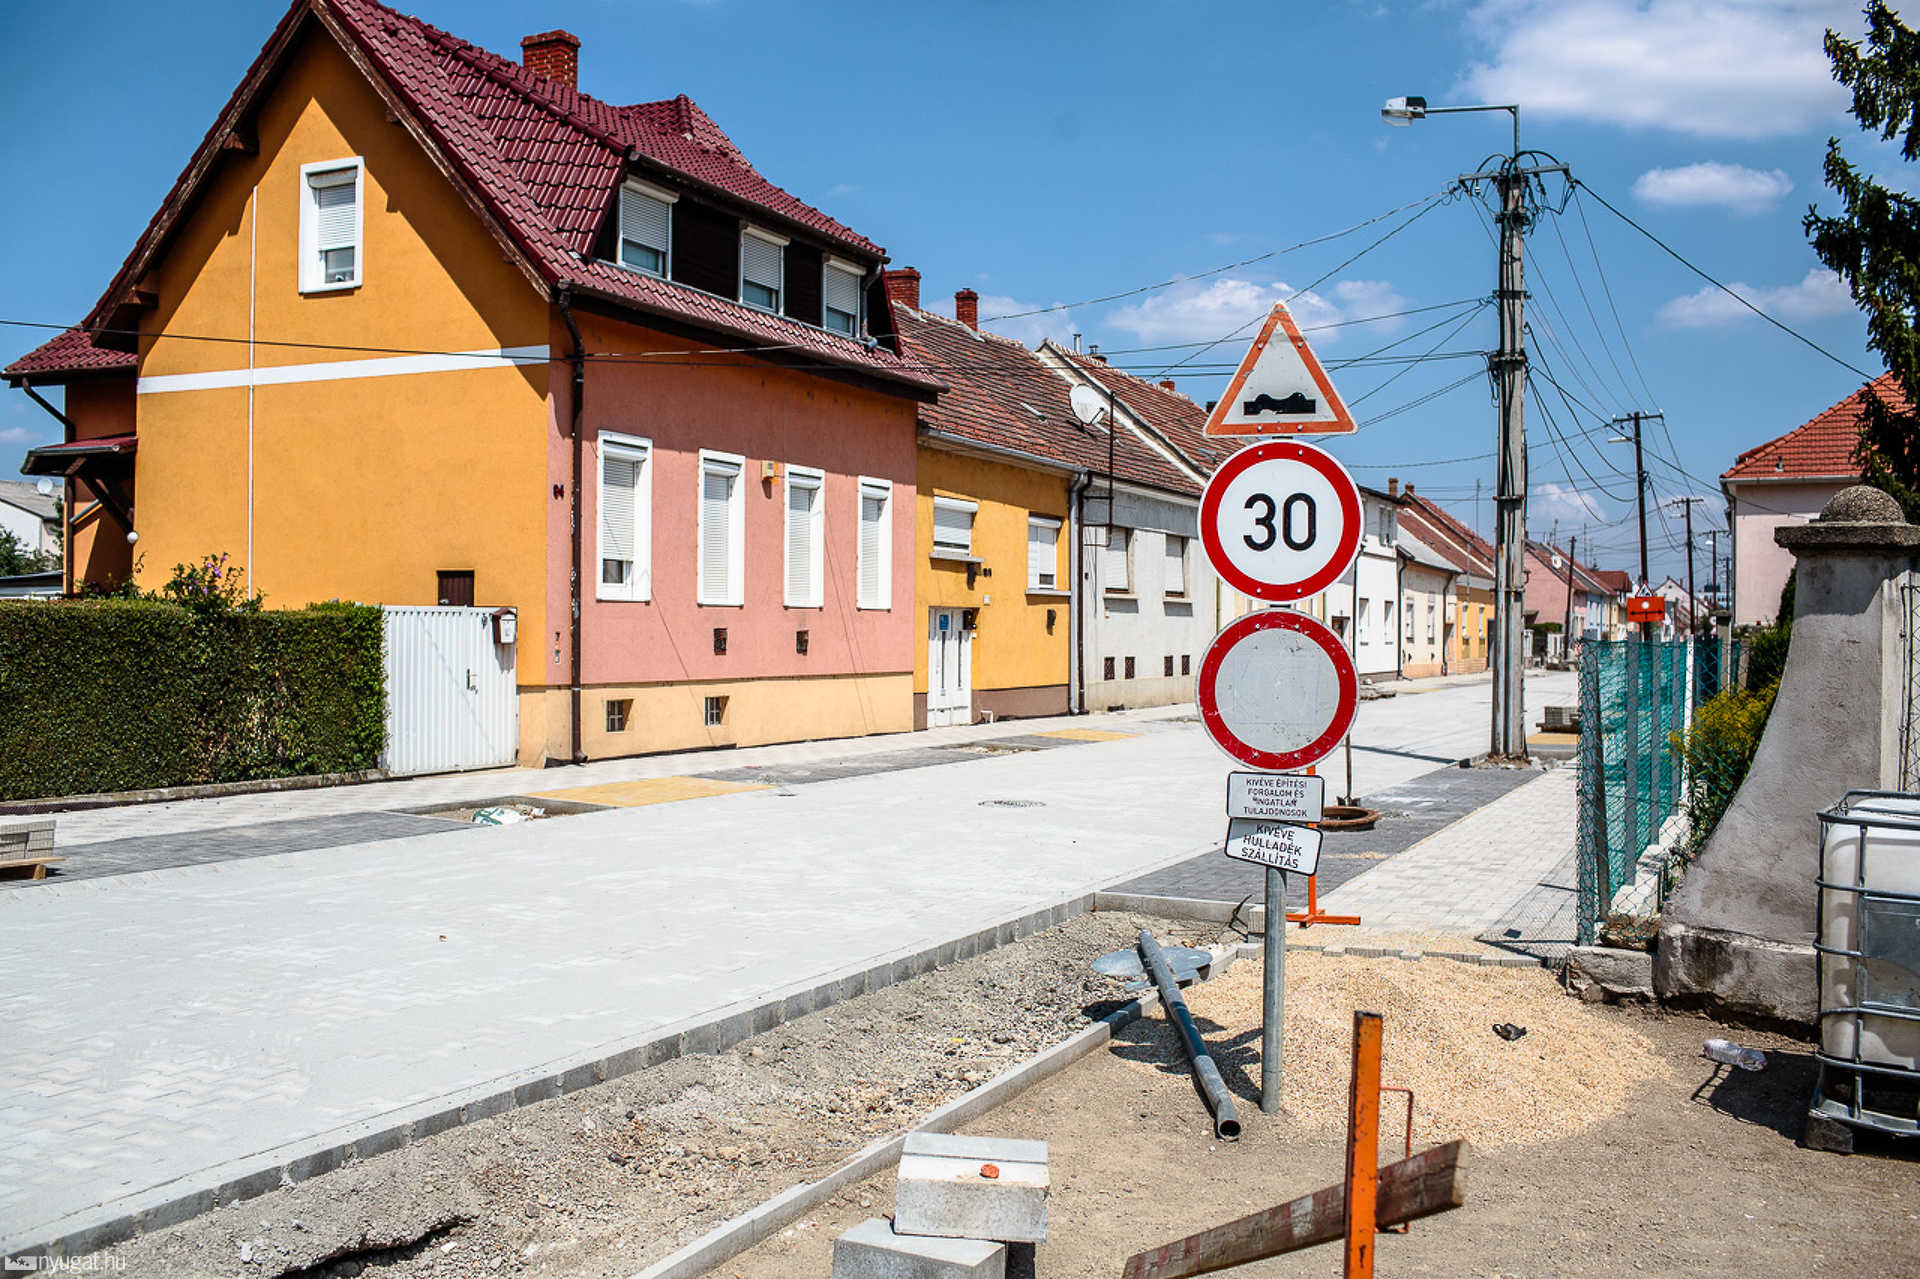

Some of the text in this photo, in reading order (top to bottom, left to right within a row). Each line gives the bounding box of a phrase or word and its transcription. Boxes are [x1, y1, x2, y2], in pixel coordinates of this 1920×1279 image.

[1243, 492, 1316, 551] 30
[1246, 777, 1275, 787] KIVÉVE
[1247, 788, 1305, 799] FORGALOM ÉS
[1243, 806, 1308, 817] TULAJDONOSOK
[1256, 823, 1295, 840] KIVÉVE
[1242, 834, 1302, 856] HULLADÉK
[1241, 846, 1299, 868] SZÁLLÍTÁS
